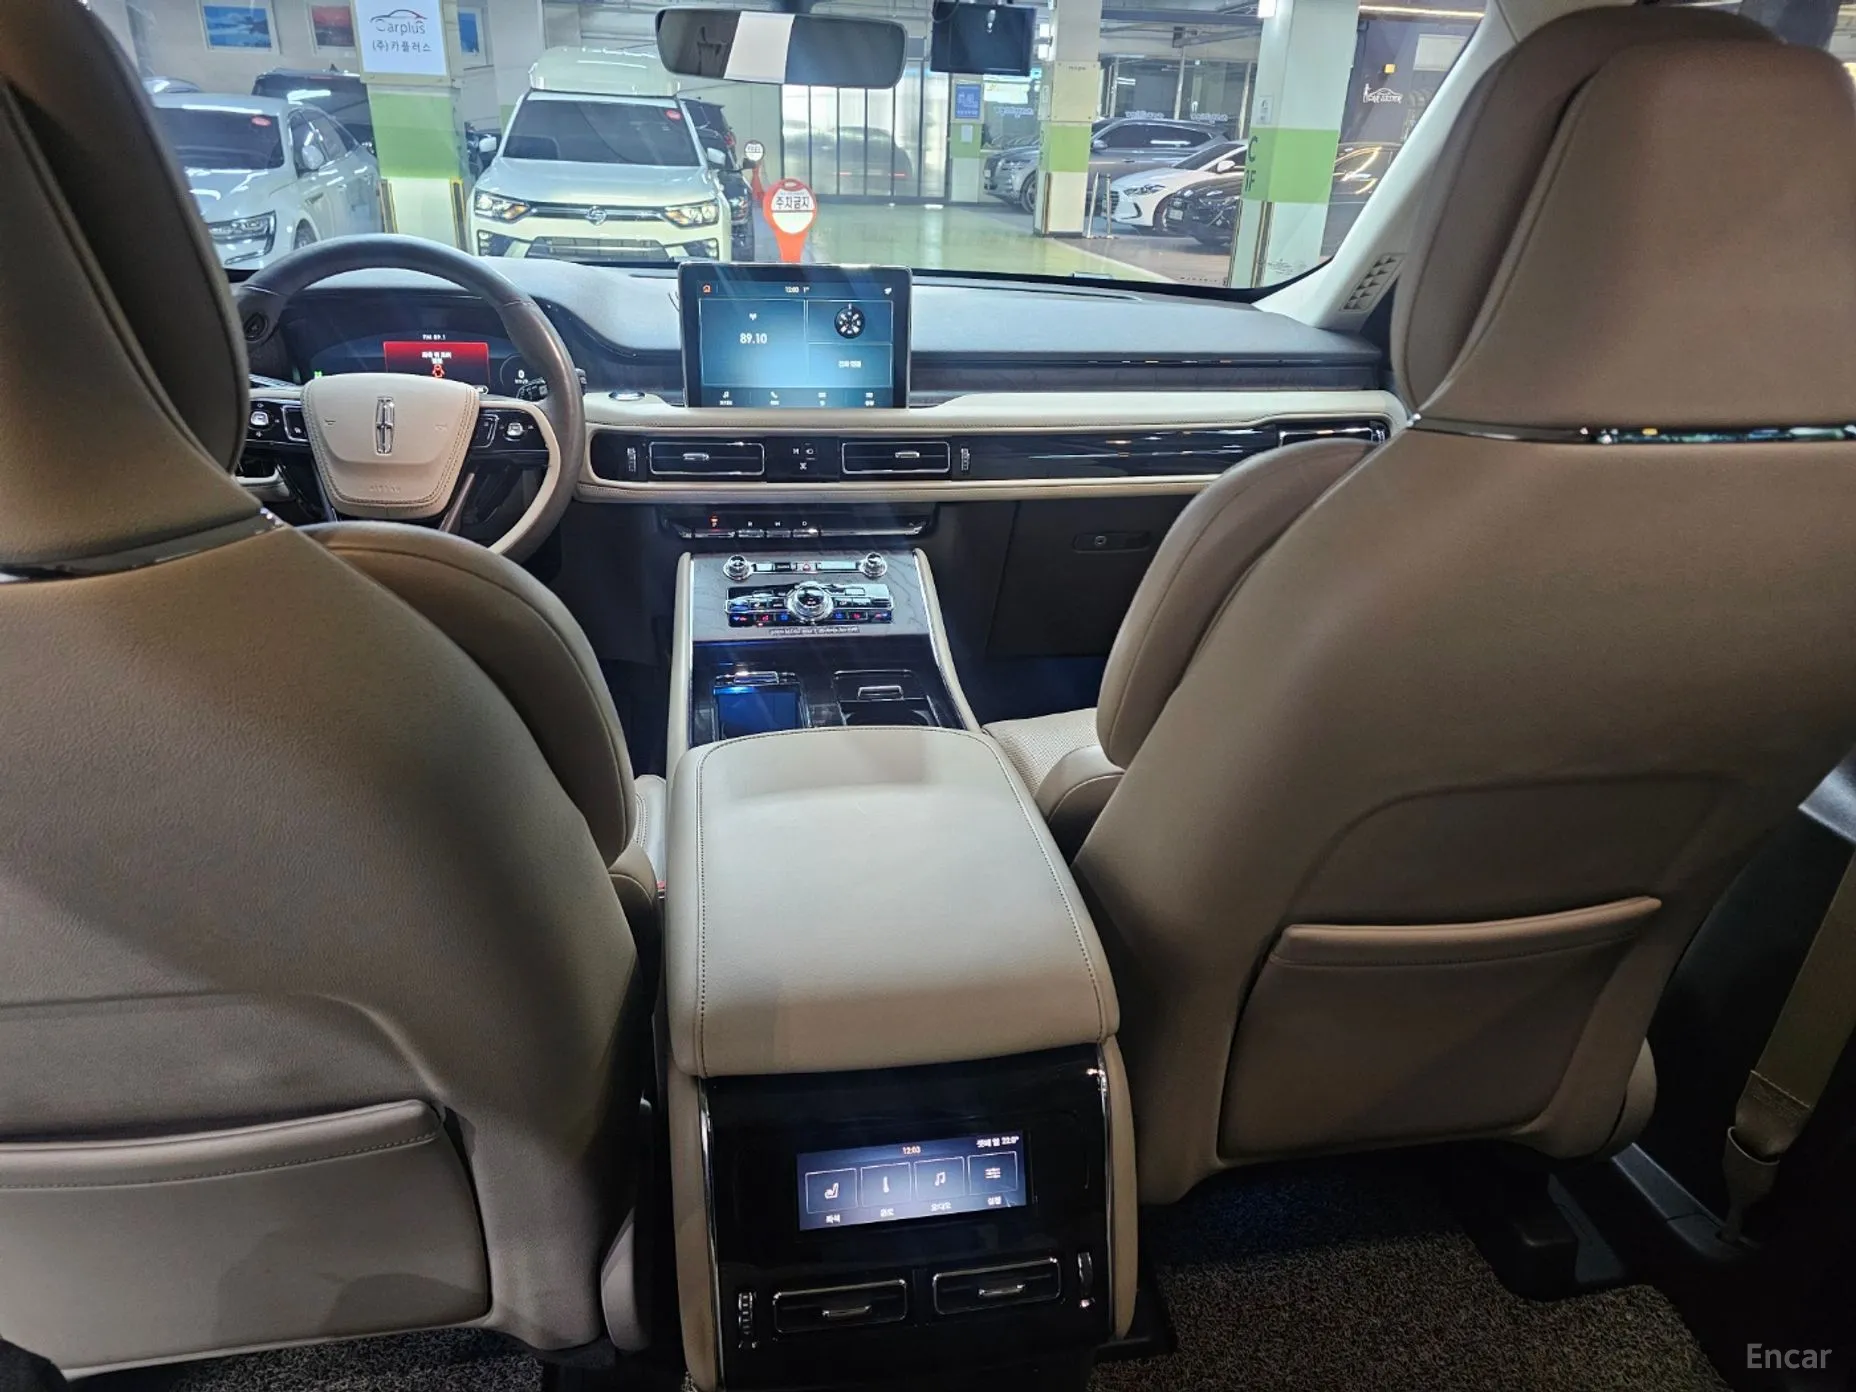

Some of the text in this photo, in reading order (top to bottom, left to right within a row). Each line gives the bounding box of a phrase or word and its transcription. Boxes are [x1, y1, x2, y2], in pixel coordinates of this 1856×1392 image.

[375, 19, 426, 36] Carplus
[372, 40, 432, 53] (주)카플러스
[1248, 136, 1258, 162] C
[775, 195, 811, 210] 주차금지
[739, 332, 768, 345] 89.10
[517, 369, 525, 379] 0
